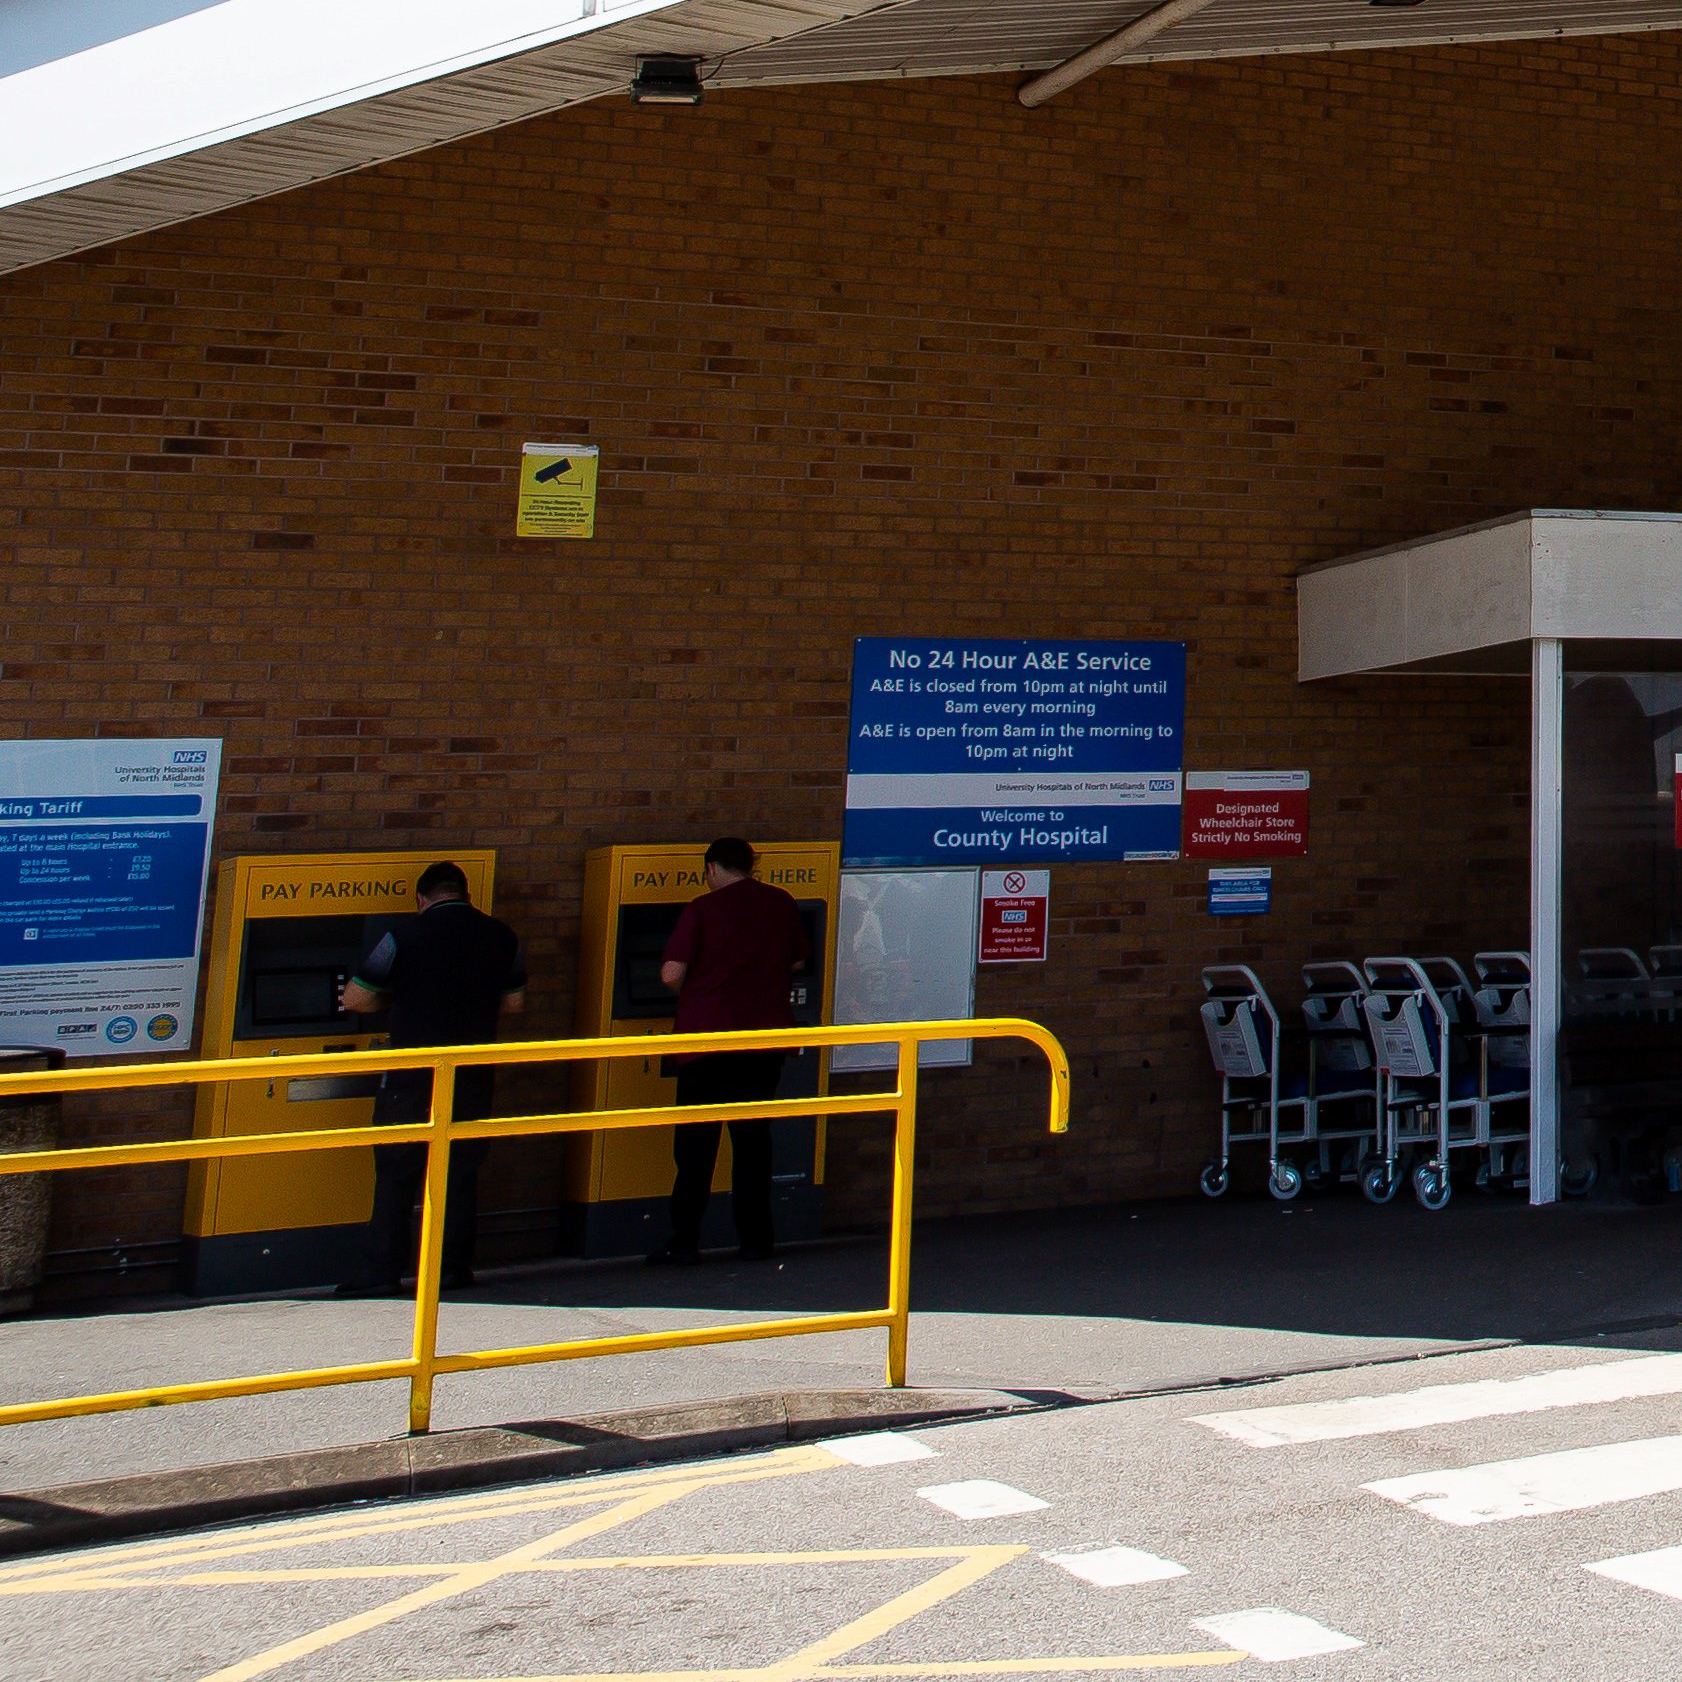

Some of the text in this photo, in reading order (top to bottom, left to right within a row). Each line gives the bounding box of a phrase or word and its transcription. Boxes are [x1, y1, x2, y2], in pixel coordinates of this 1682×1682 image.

[889, 650, 1152, 671] No 24 Hour A&E Service
[870, 679, 1167, 697] A&E is closed from 10pm at night until
[944, 700, 1096, 717] 8am every morning
[859, 724, 1173, 742] A&E is open from 8am in the morning to
[174, 750, 207, 763] NHS
[965, 744, 1074, 761] 10pm at night
[115, 765, 206, 775] University Hospitals
[119, 773, 205, 782] of North Midlands
[995, 779, 1175, 793] University Hospitals of North Midlands NHS
[39, 800, 83, 815] Tariff
[1216, 802, 1280, 816] Designated
[980, 809, 1065, 822] Welcome to
[1199, 817, 1295, 828] Wheelchair Store
[933, 825, 1108, 851] County Hospital
[1191, 830, 1302, 845] Strictly No Smoking
[633, 871, 669, 888] PAY
[770, 868, 818, 884] HERE
[261, 879, 407, 900] PAY PARKING
